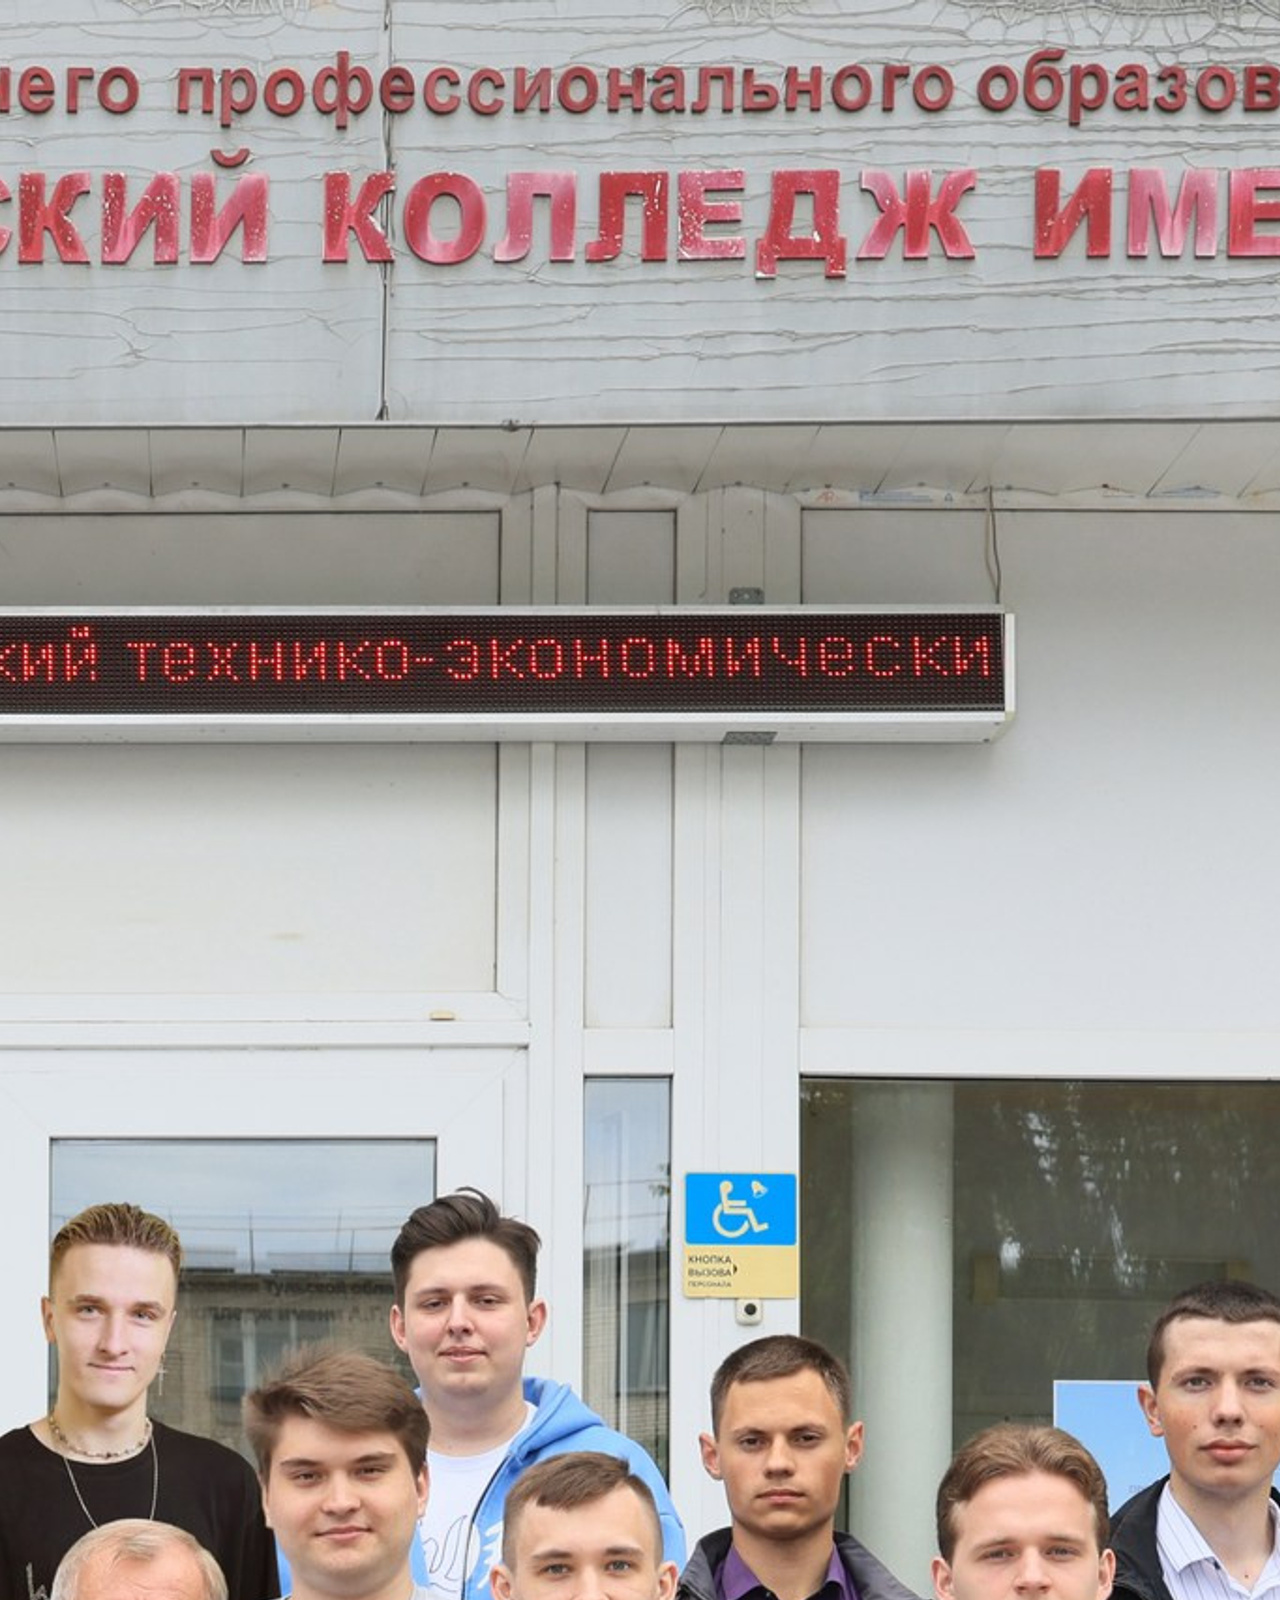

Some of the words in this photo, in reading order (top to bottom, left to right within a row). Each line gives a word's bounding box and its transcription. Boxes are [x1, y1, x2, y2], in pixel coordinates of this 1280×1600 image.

[176, 50, 954, 129] профессионального
[977, 49, 1280, 126] образов
[322, 169, 977, 279] КОЛЛЕДЖ
[1034, 167, 1280, 260] ИМЕ
[125, 634, 992, 684] технико-экономически
[688, 1255, 732, 1264] КНОПКА
[688, 1268, 732, 1277] ВЫЗОВА
[688, 1280, 732, 1288] ПЕРСОНАЛА
